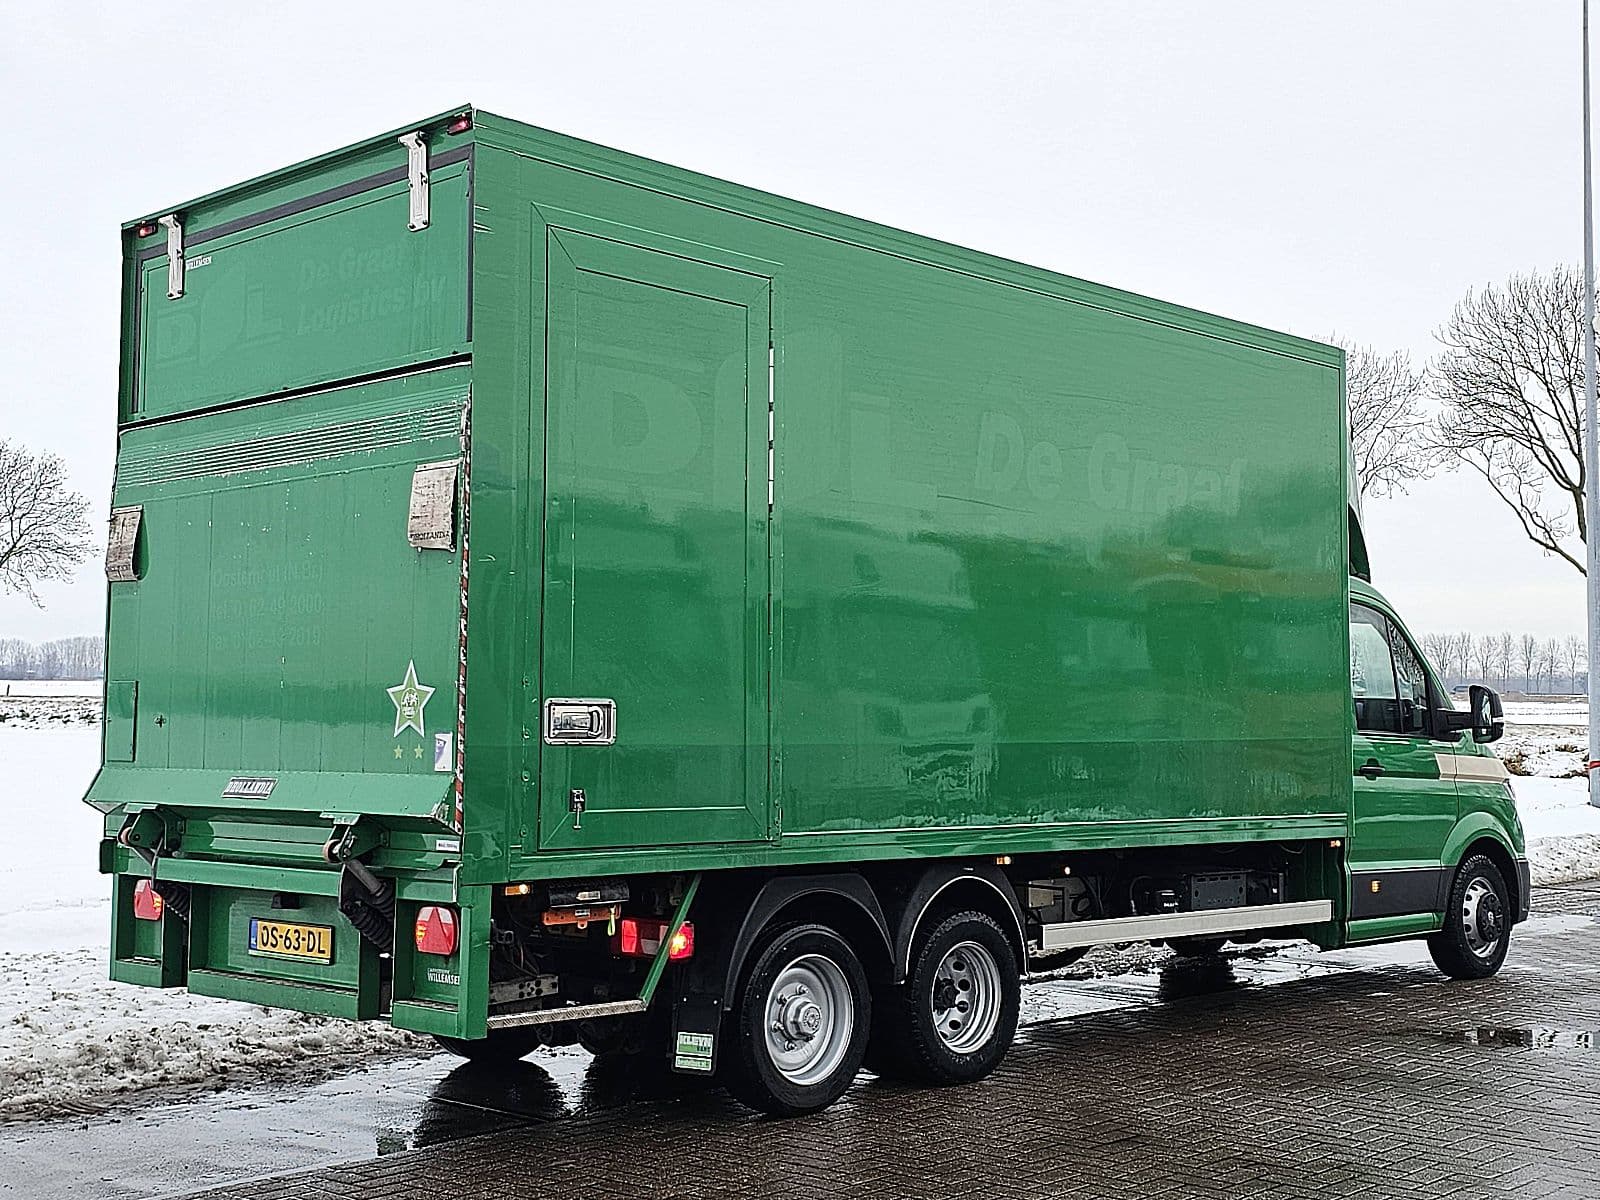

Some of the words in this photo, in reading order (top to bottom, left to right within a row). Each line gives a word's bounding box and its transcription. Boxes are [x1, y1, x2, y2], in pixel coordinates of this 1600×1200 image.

[973, 408, 1064, 500] De
[1088, 430, 1249, 517] Graaf
[261, 925, 326, 955] OS-63-DL
